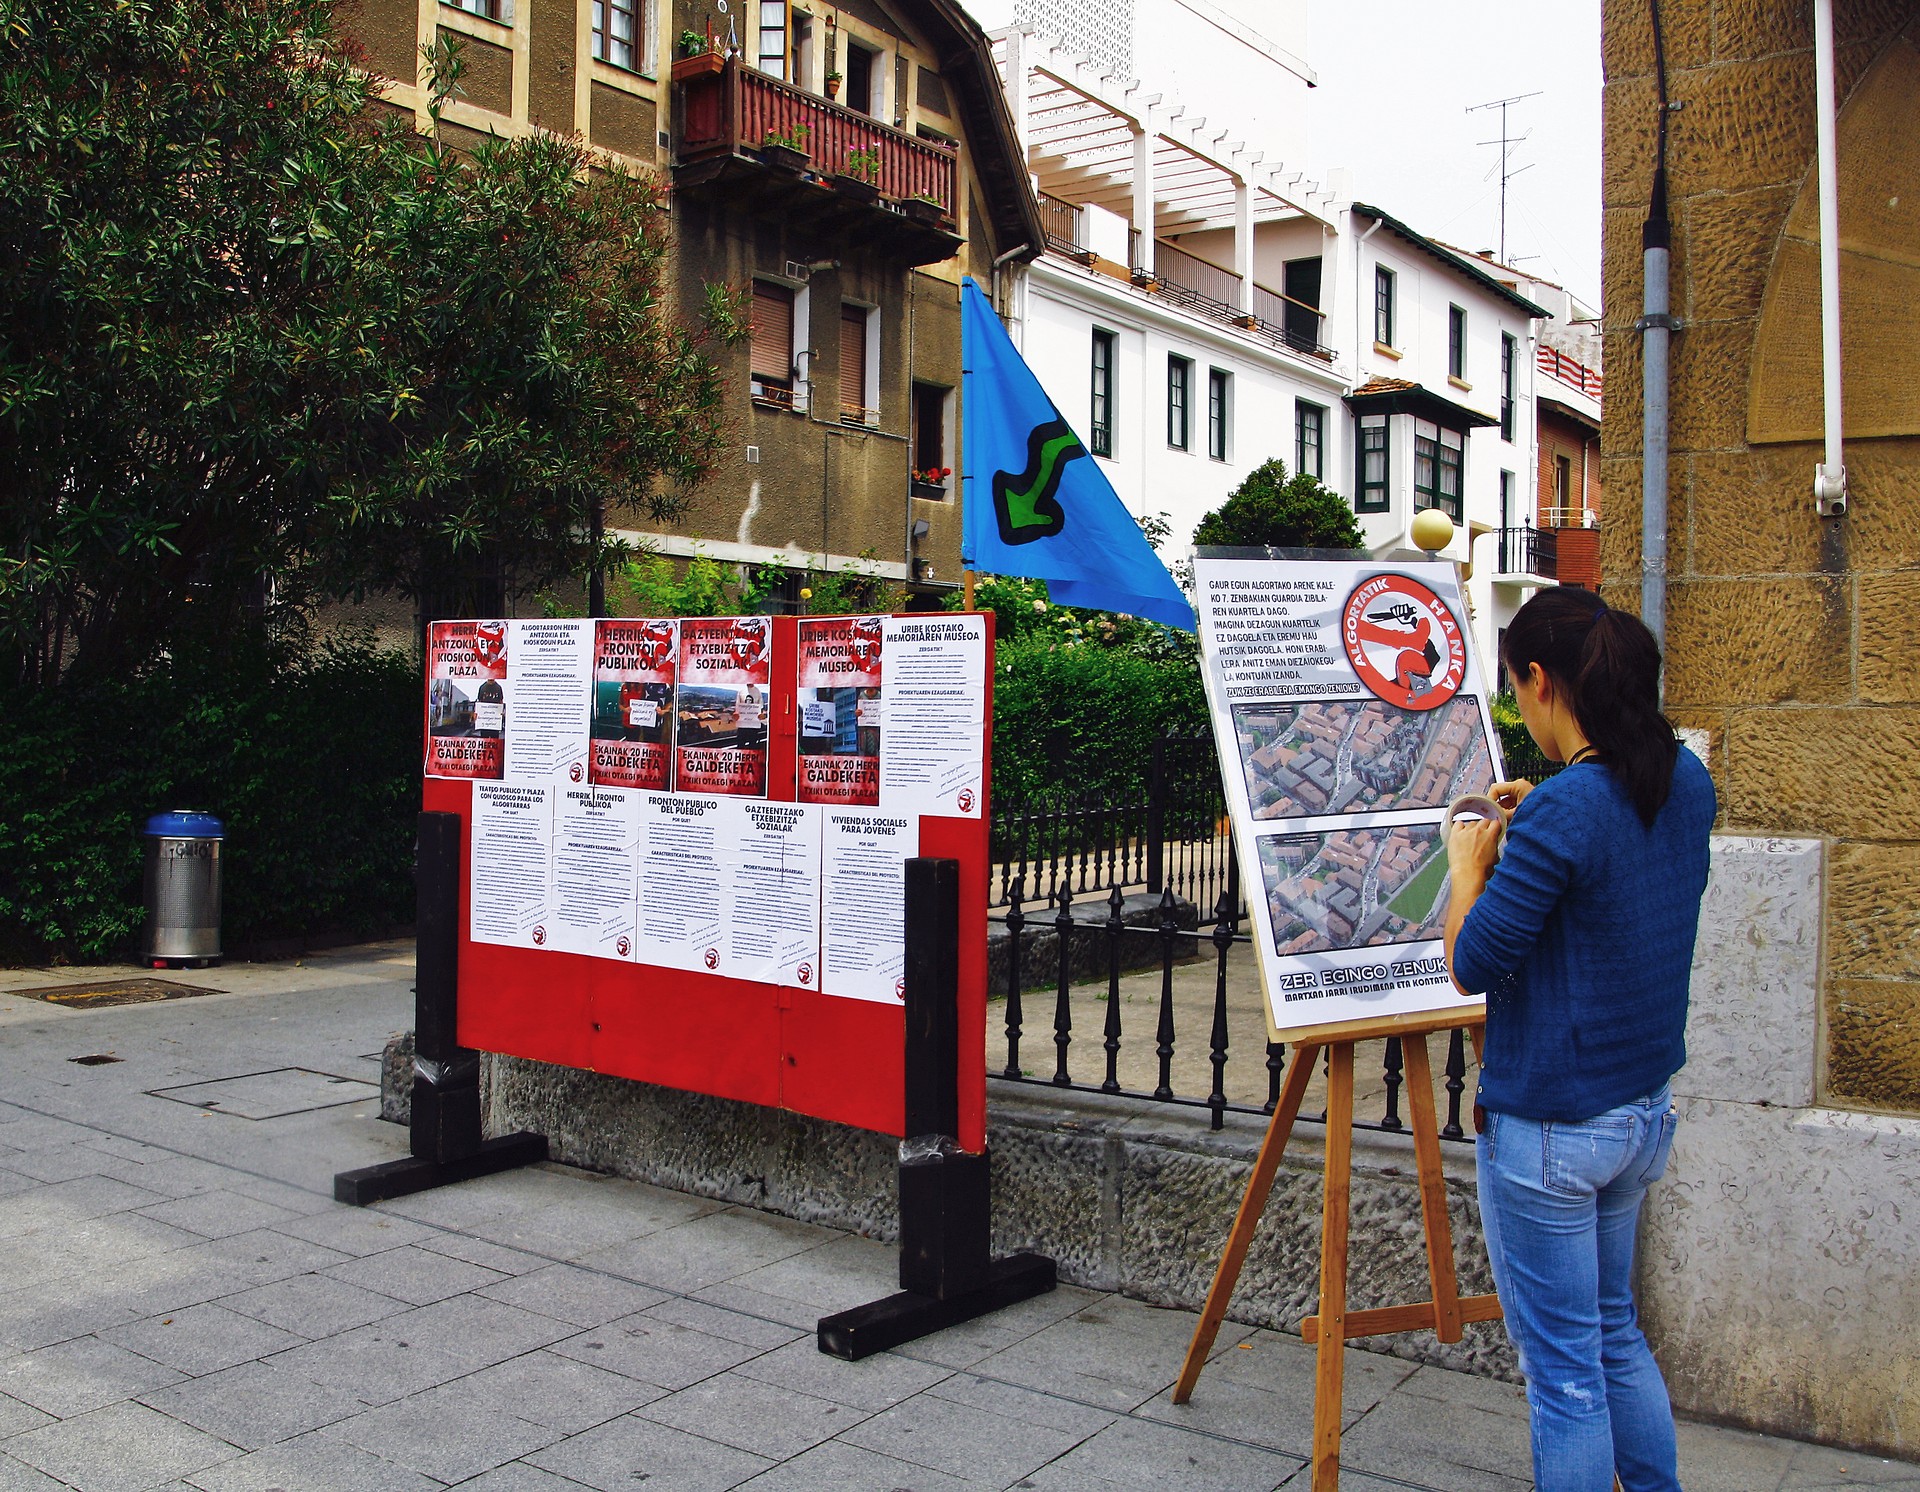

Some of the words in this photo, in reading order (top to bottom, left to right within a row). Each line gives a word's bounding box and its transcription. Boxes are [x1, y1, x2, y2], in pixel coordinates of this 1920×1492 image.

[1208, 580, 1230, 590] GAUR
[1230, 580, 1250, 590] EGUN
[1252, 581, 1292, 590] ALGORTAKO
[1294, 582, 1315, 590] ARENE
[1316, 581, 1336, 590] KALE-
[1210, 594, 1220, 603] KO
[1230, 594, 1270, 603] ZENBAKIAN
[1272, 594, 1304, 603] GUARDIA
[1212, 607, 1226, 616] REN
[1228, 607, 1265, 616] KUARTELA
[1266, 607, 1290, 616] DAGO.
[1214, 621, 1245, 630] IMAGINA
[1247, 620, 1281, 629] DEZAGUN
[1282, 620, 1321, 628] KUARTELIK
[1346, 578, 1390, 667] ALGORTATIK
[901, 624, 924, 634] URIBE
[925, 624, 964, 632] KOSTAKO
[801, 630, 828, 642] URIBE
[886, 633, 942, 642] MEMORIAREN
[944, 632, 980, 641] MUSEOA
[1216, 634, 1226, 642] EZ
[1227, 634, 1260, 642] DAGOELA
[1263, 633, 1276, 642] ETA
[1277, 632, 1300, 641] EREMU
[1302, 632, 1318, 640] HAU
[603, 642, 655, 656] FRONTOI
[1219, 647, 1248, 656] HUTSIK
[1285, 645, 1304, 654] HONI
[1429, 599, 1463, 691] HANKA
[598, 656, 658, 670] PUBLIKOA
[696, 658, 748, 670] SOZIALAK
[818, 661, 862, 673] MUSEOA
[1221, 660, 1240, 669] LERA
[1242, 659, 1264, 668] ANITZ
[1266, 658, 1286, 667] EMAN
[448, 666, 478, 676] PLAZA
[1236, 672, 1272, 681] KONTUAN
[1272, 671, 1302, 680] IZANDA.
[1226, 687, 1243, 697] ZUK
[1294, 684, 1326, 695] EMANGO
[1327, 683, 1360, 694] ZENIOKE?
[434, 740, 466, 748] EKAINAK
[467, 740, 476, 748] 20
[437, 748, 495, 760] GALDEKETA
[630, 748, 640, 757] 20
[682, 750, 720, 760] EKAINAK
[722, 752, 732, 762] 20
[596, 755, 660, 770] GALDEKETA
[686, 760, 755, 774] GALDEKETA
[804, 759, 840, 769] EKAINAK
[843, 760, 854, 770] 20
[702, 778, 728, 786] OTAEGI
[807, 770, 876, 784] GALDEKETA
[526, 788, 545, 796] PLAZA
[824, 788, 850, 796] OTAEGI
[596, 794, 625, 803] FRONTOI
[648, 796, 684, 807] FRONTON
[685, 800, 718, 810] PUBLICO
[660, 805, 674, 814] DEL
[675, 806, 704, 816] PUEBLO
[744, 805, 804, 817] GAZTEENTZAKO
[751, 814, 798, 824] ETXEBIZITZA
[831, 816, 871, 826] VIVIENDAS
[872, 818, 908, 828] SOCIALES
[756, 822, 793, 832] SOZIALAK
[841, 824, 862, 834] PARA
[863, 826, 896, 836] JOVENES
[1280, 973, 1317, 990] ZER
[1321, 964, 1388, 985] EGINGO
[1284, 990, 1324, 1002] MARTXAN
[1325, 988, 1348, 998] JARRI
[1350, 982, 1395, 994] IRUDIMENA
[1397, 980, 1411, 989] ETA
[1412, 976, 1449, 987] KONTATU
